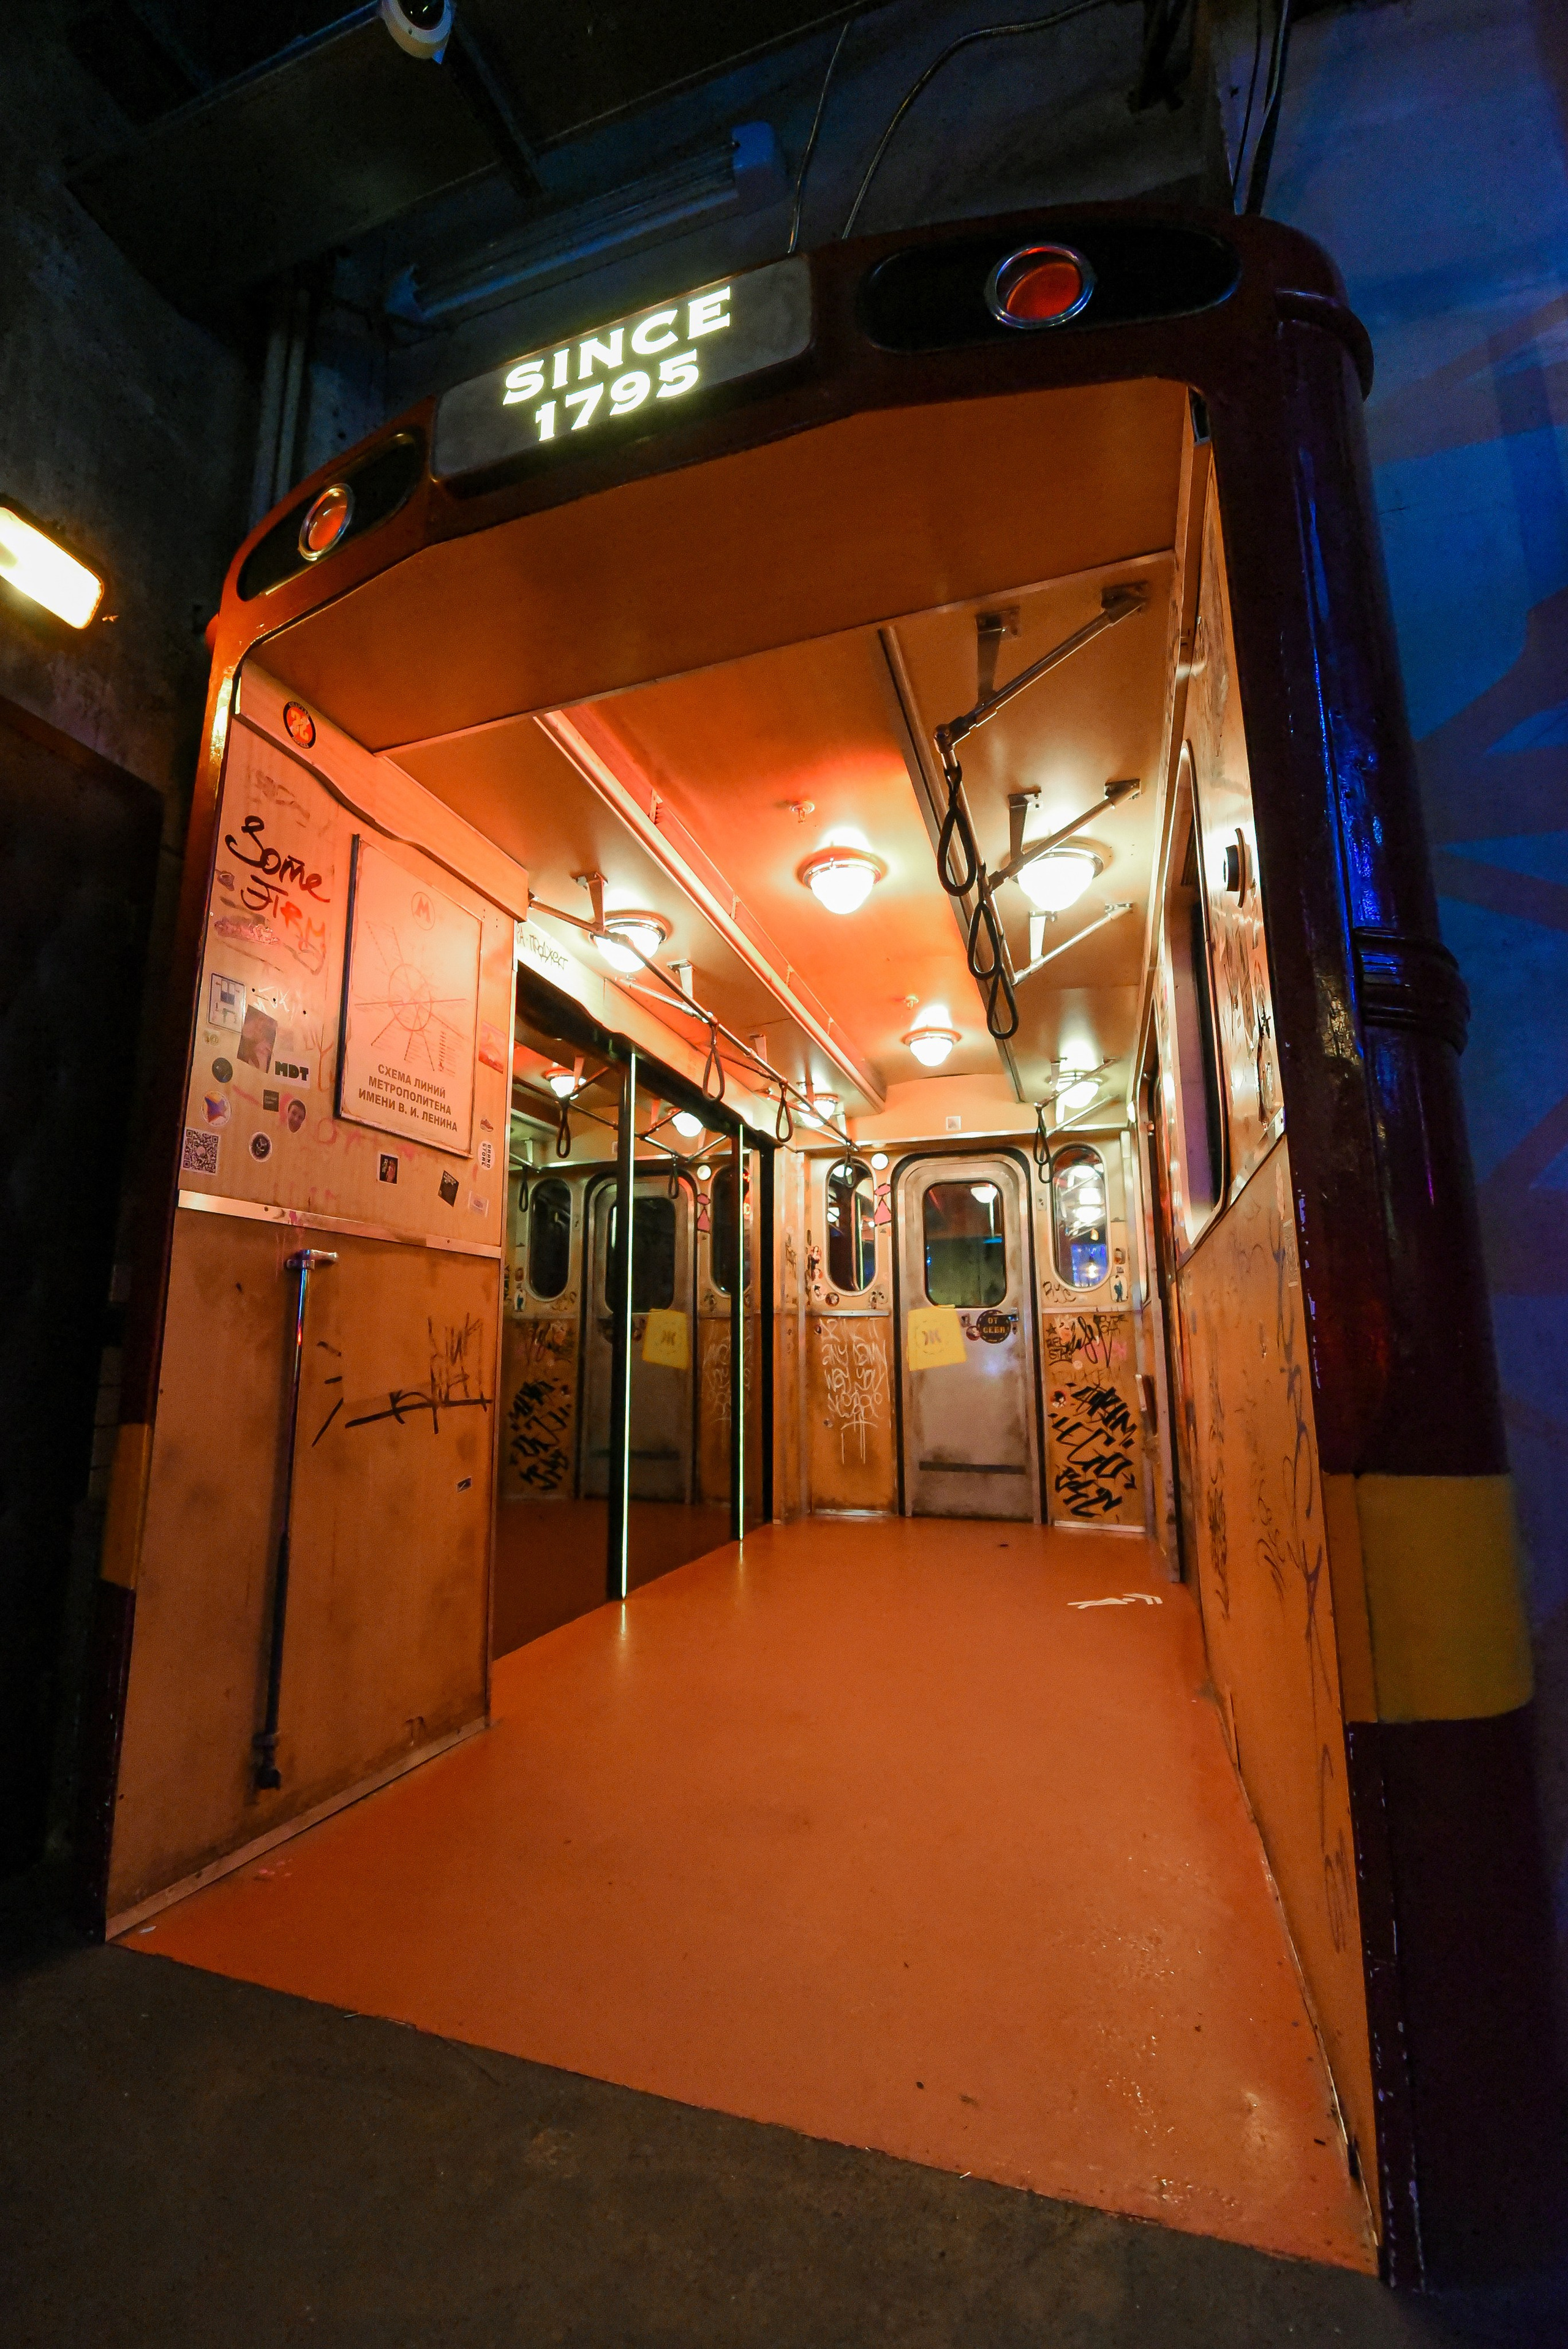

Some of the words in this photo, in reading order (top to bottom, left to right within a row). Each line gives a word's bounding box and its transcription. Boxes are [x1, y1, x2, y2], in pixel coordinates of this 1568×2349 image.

[502, 285, 731, 405] SINCE
[535, 349, 699, 442] 1795
[274, 1060, 309, 1082] MDT
[377, 1064, 412, 1085] СХЕМА
[414, 1077, 446, 1098] ЛИНИЙ
[358, 1088, 396, 1110] ИМЕНИ
[398, 1102, 407, 1114] В.
[410, 1106, 419, 1118] И.
[421, 1110, 458, 1132] ЛЕНИНА
[369, 1076, 451, 1115] МЕТРОПОЛИТЕНА
